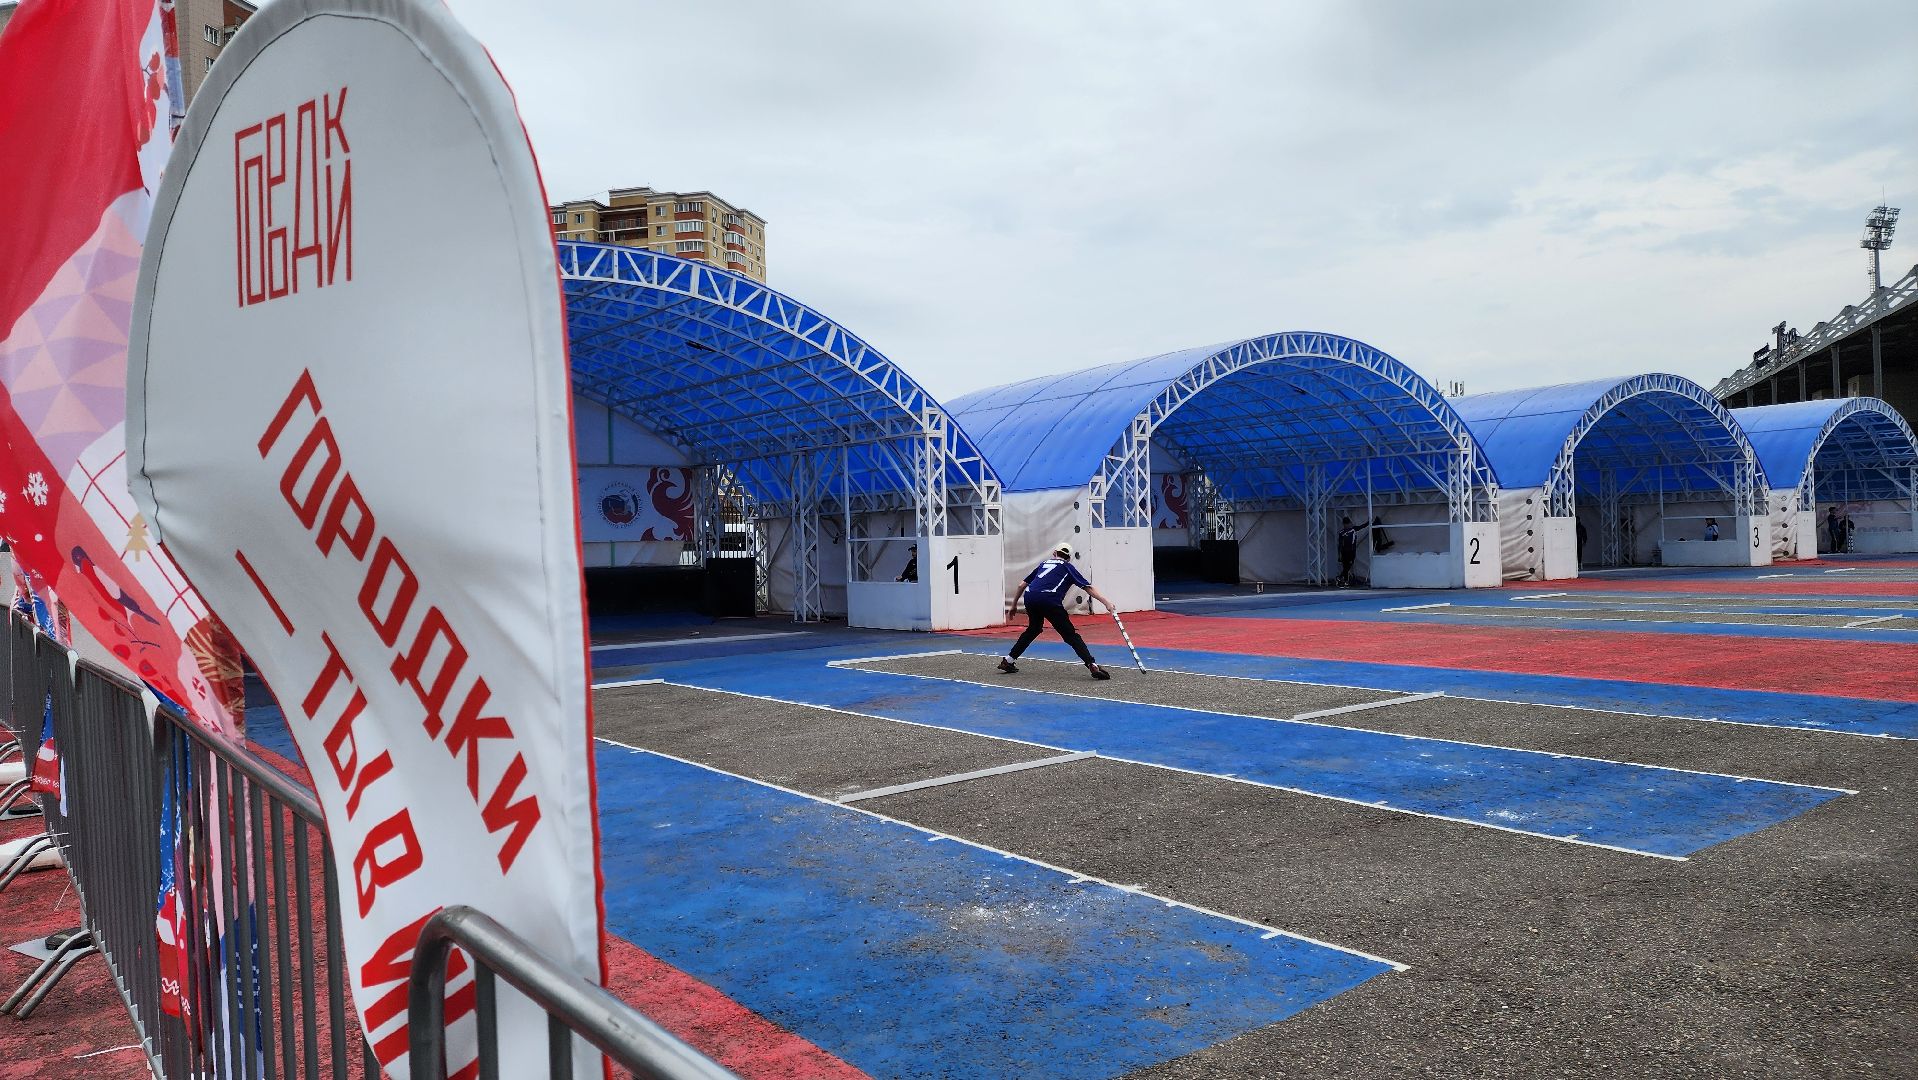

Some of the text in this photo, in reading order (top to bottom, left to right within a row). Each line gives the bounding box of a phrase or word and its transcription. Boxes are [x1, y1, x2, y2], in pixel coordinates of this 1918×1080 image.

[1469, 537, 1481, 565] 2
[1753, 526, 1760, 548] 3
[946, 555, 958, 594] 1
[1037, 563, 1058, 579] 7
[257, 367, 542, 875] ГОРОДКИ
[301, 631, 394, 821] ТЫ
[353, 807, 424, 919] В
